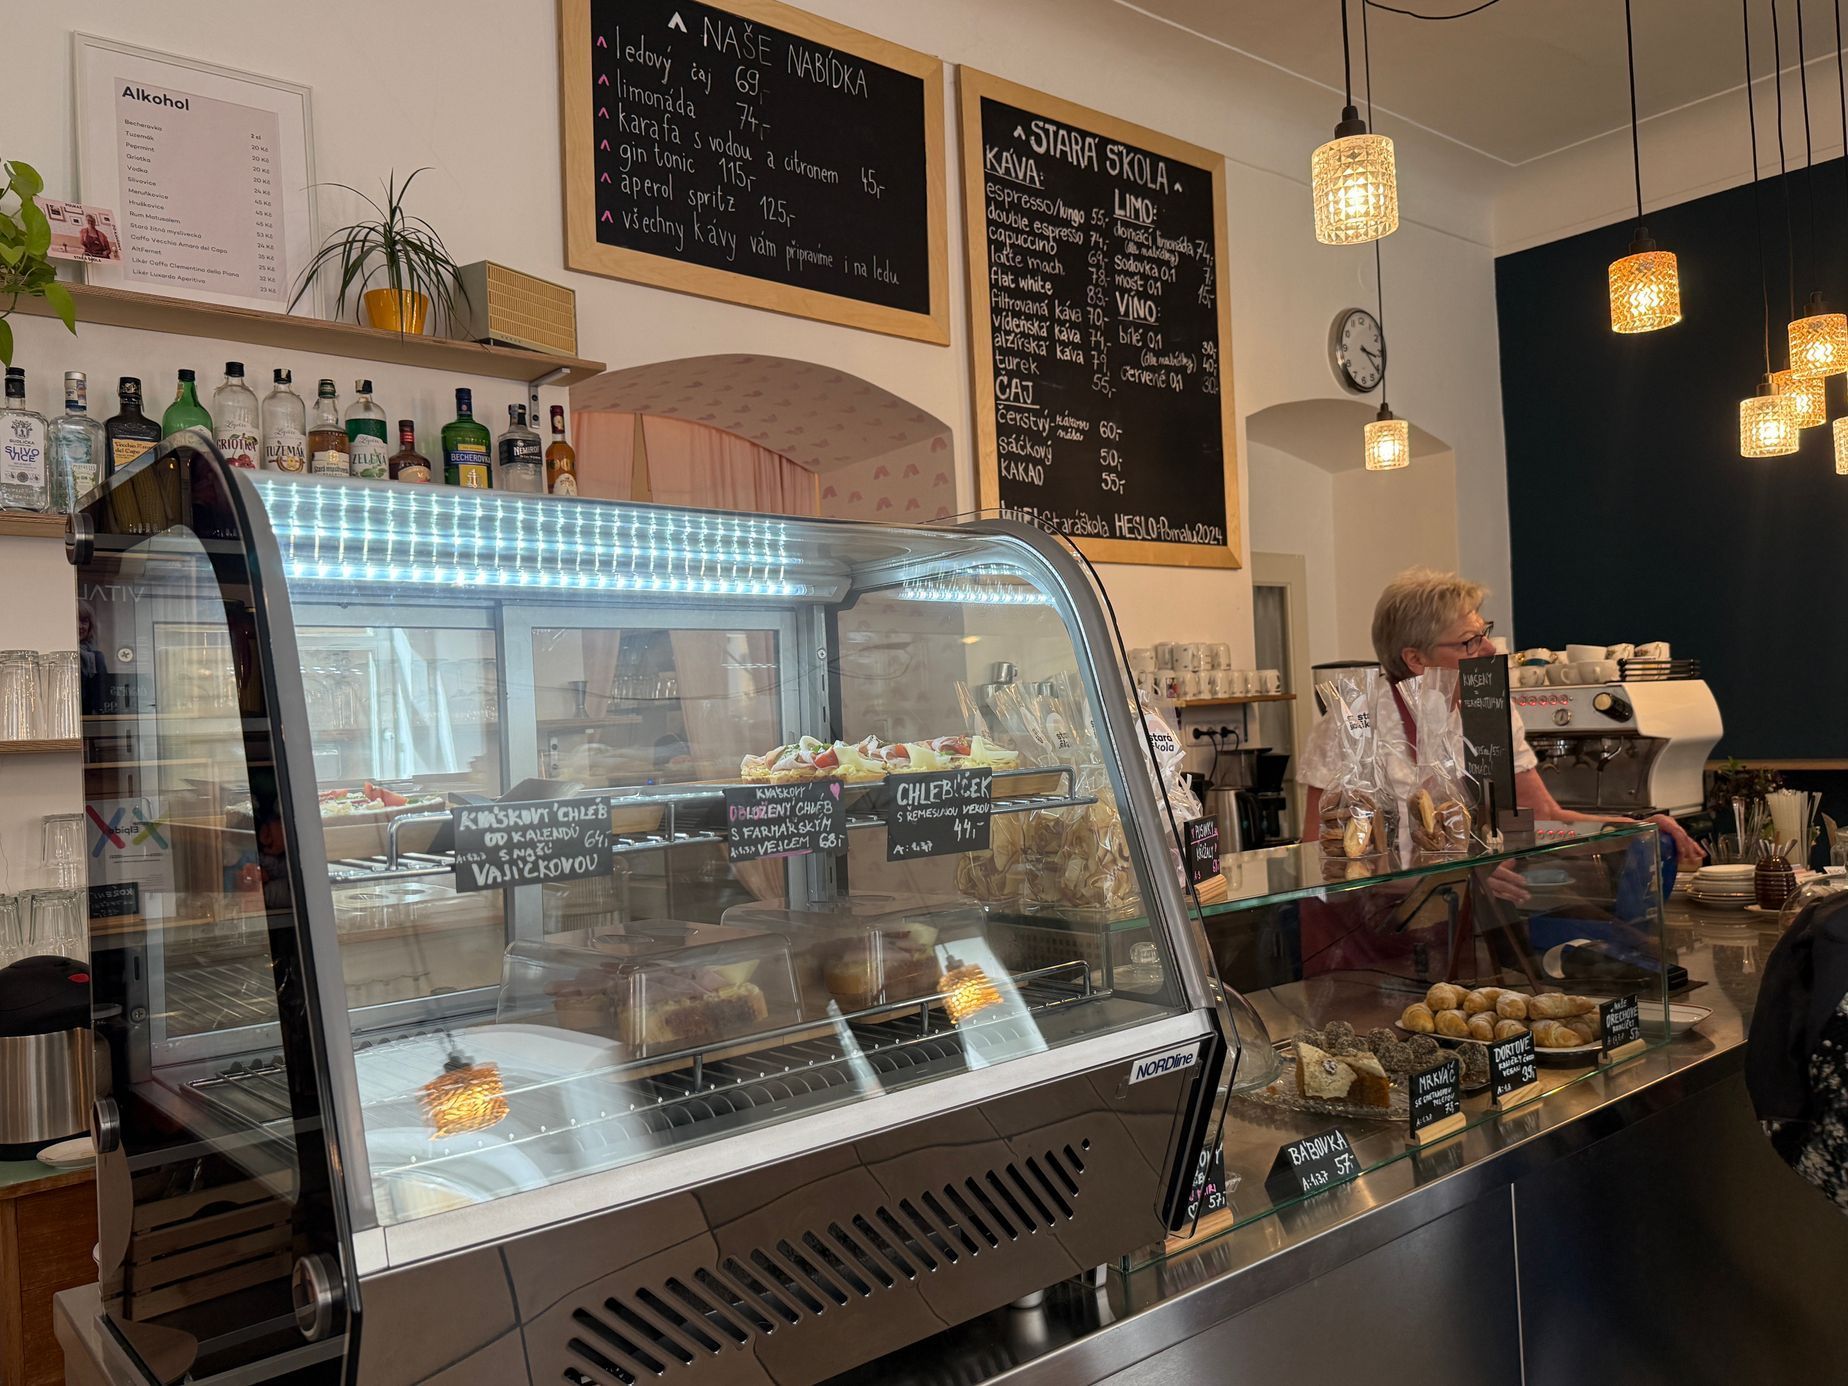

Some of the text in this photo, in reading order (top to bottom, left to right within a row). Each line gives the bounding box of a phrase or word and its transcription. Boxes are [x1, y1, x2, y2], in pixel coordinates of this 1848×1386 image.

[616, 26, 672, 84] ledový
[691, 63, 712, 95] čaj
[704, 16, 868, 98] NAŠE NABÍDKA
[122, 86, 190, 111] Alkohol
[617, 69, 696, 119] limonáda
[618, 102, 681, 145] karafa
[694, 131, 702, 149] s
[709, 130, 752, 161] vodou
[767, 151, 775, 170] a
[784, 150, 839, 184] citronem
[620, 144, 647, 172] gin
[654, 143, 695, 174] tonic
[1030, 120, 1168, 194] STARÁ ŠKOLA
[621, 173, 673, 201] aperol
[688, 185, 736, 214] spritz
[988, 201, 1030, 231] double
[1033, 220, 1083, 245] espresso
[1114, 221, 1153, 246] domácí
[1157, 230, 1194, 256] limonáda
[622, 206, 900, 286] všechny kávy vám připravíme i na ledu
[989, 226, 1057, 255] capuccino
[991, 244, 1024, 267] latte
[991, 267, 1016, 288] flat
[1019, 275, 1053, 295] white
[991, 289, 1049, 316] filtrovaná
[1055, 300, 1082, 322] káva
[992, 312, 1050, 337] vídeňská
[1055, 322, 1081, 343] káva
[1120, 325, 1143, 346] bílé
[995, 350, 1039, 374] turek
[1056, 343, 1084, 364] káva
[996, 370, 1033, 403] ČAJ
[5, 445, 40, 457] SLIVO
[9, 453, 36, 463] VICE
[1001, 458, 1043, 486] KAKAO
[484, 831, 508, 847] OD
[1136, 1053, 1193, 1080] NORDline
[1288, 1129, 1348, 1165] BÁBOVKA
